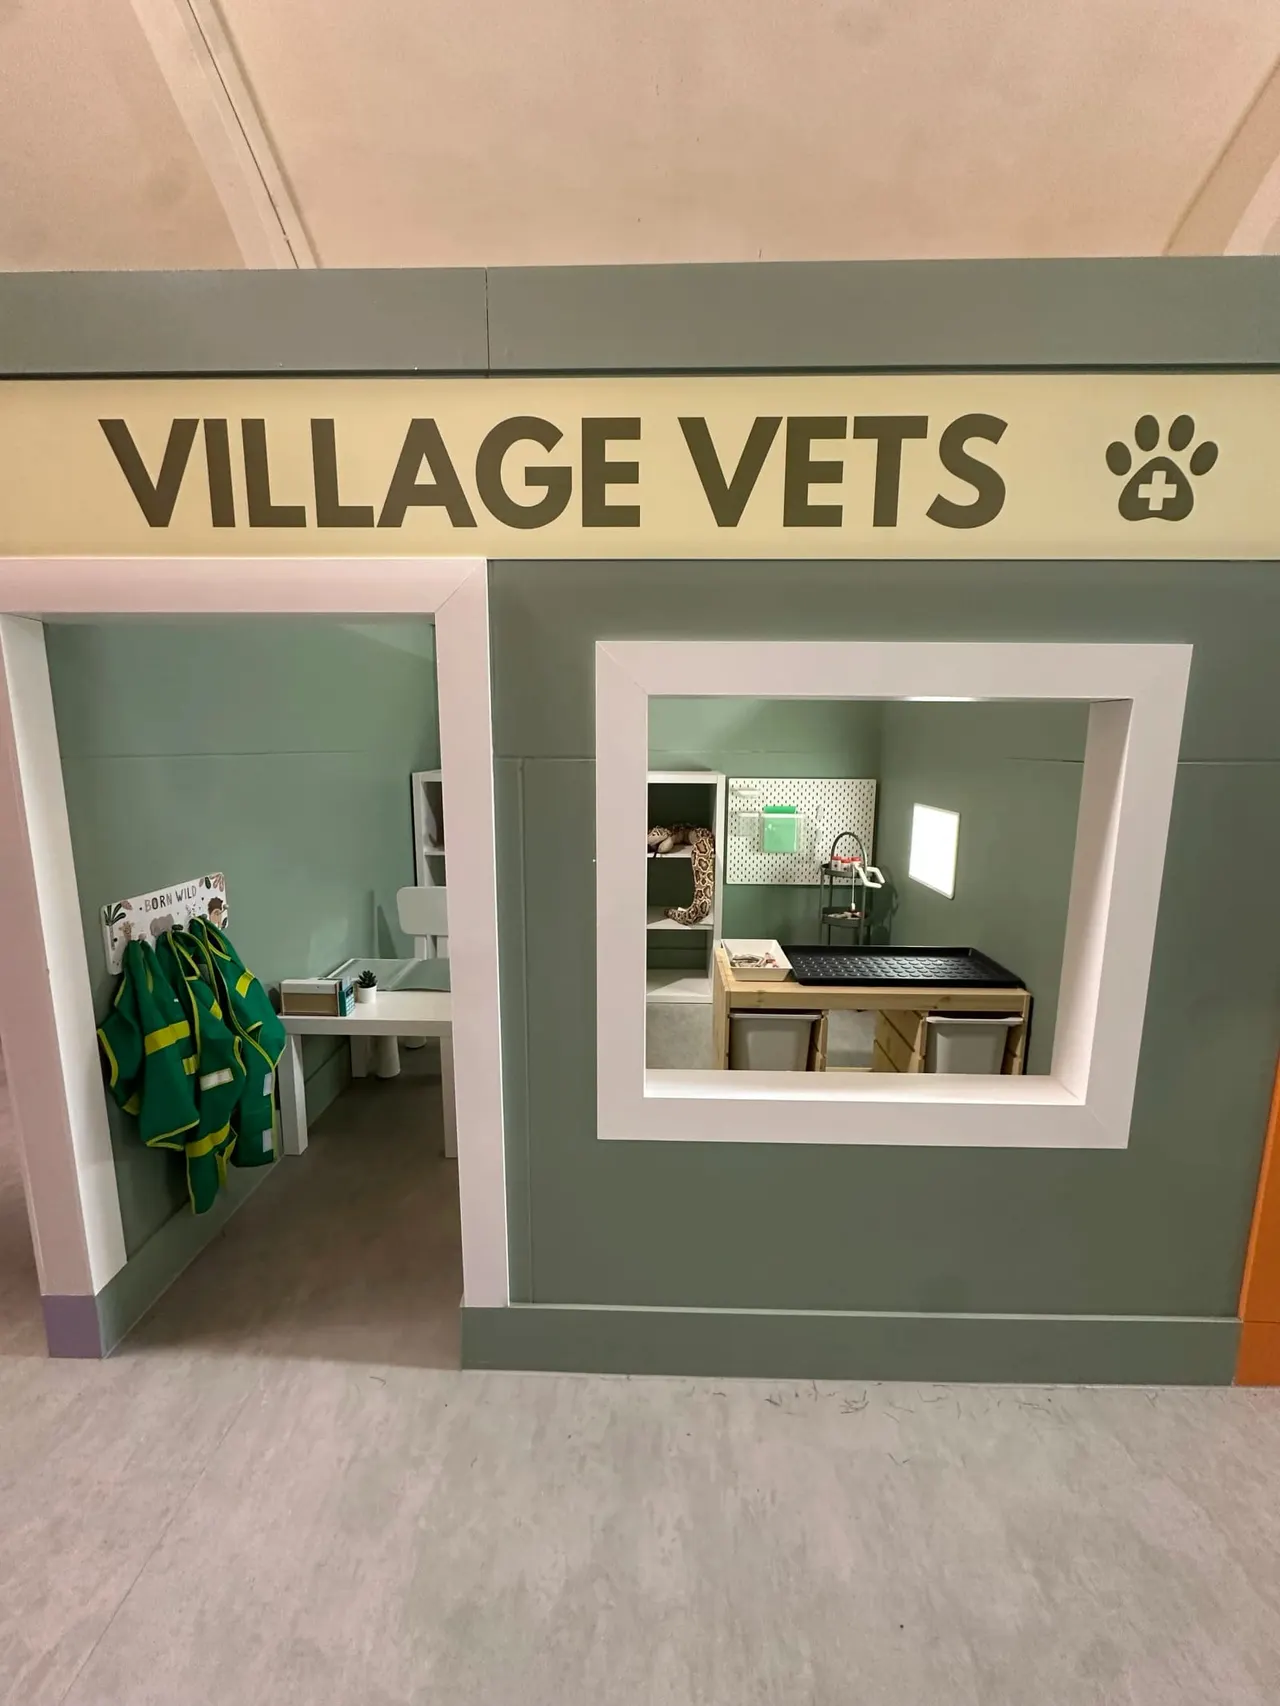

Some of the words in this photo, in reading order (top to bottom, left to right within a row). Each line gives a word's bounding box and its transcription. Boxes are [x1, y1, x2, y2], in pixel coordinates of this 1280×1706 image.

[98, 415, 641, 530] VILLAGE
[677, 412, 1008, 529] VETS
[145, 893, 172, 912] BORN
[175, 886, 196, 902] WILD
